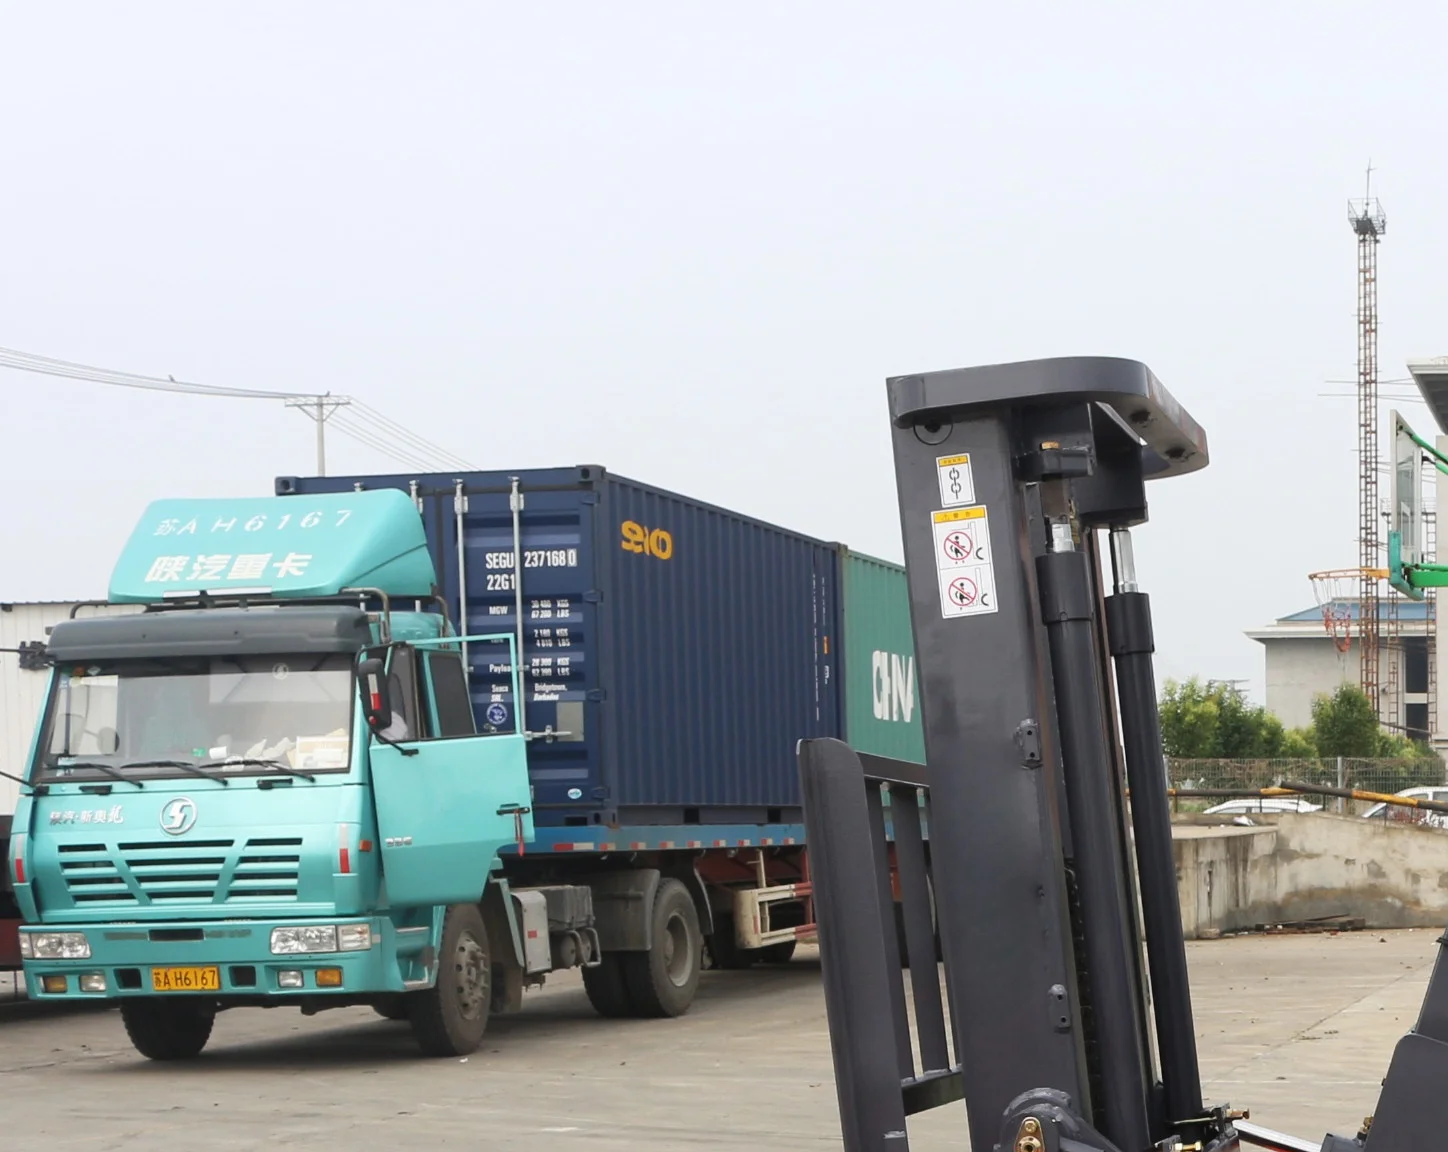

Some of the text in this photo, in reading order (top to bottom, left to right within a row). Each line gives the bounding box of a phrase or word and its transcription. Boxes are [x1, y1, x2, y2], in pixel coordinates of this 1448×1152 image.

[485, 552, 514, 569] SEGU
[486, 574, 515, 590] 22G1
[489, 606, 508, 615] MGW
[489, 664, 512, 674] Payloa
